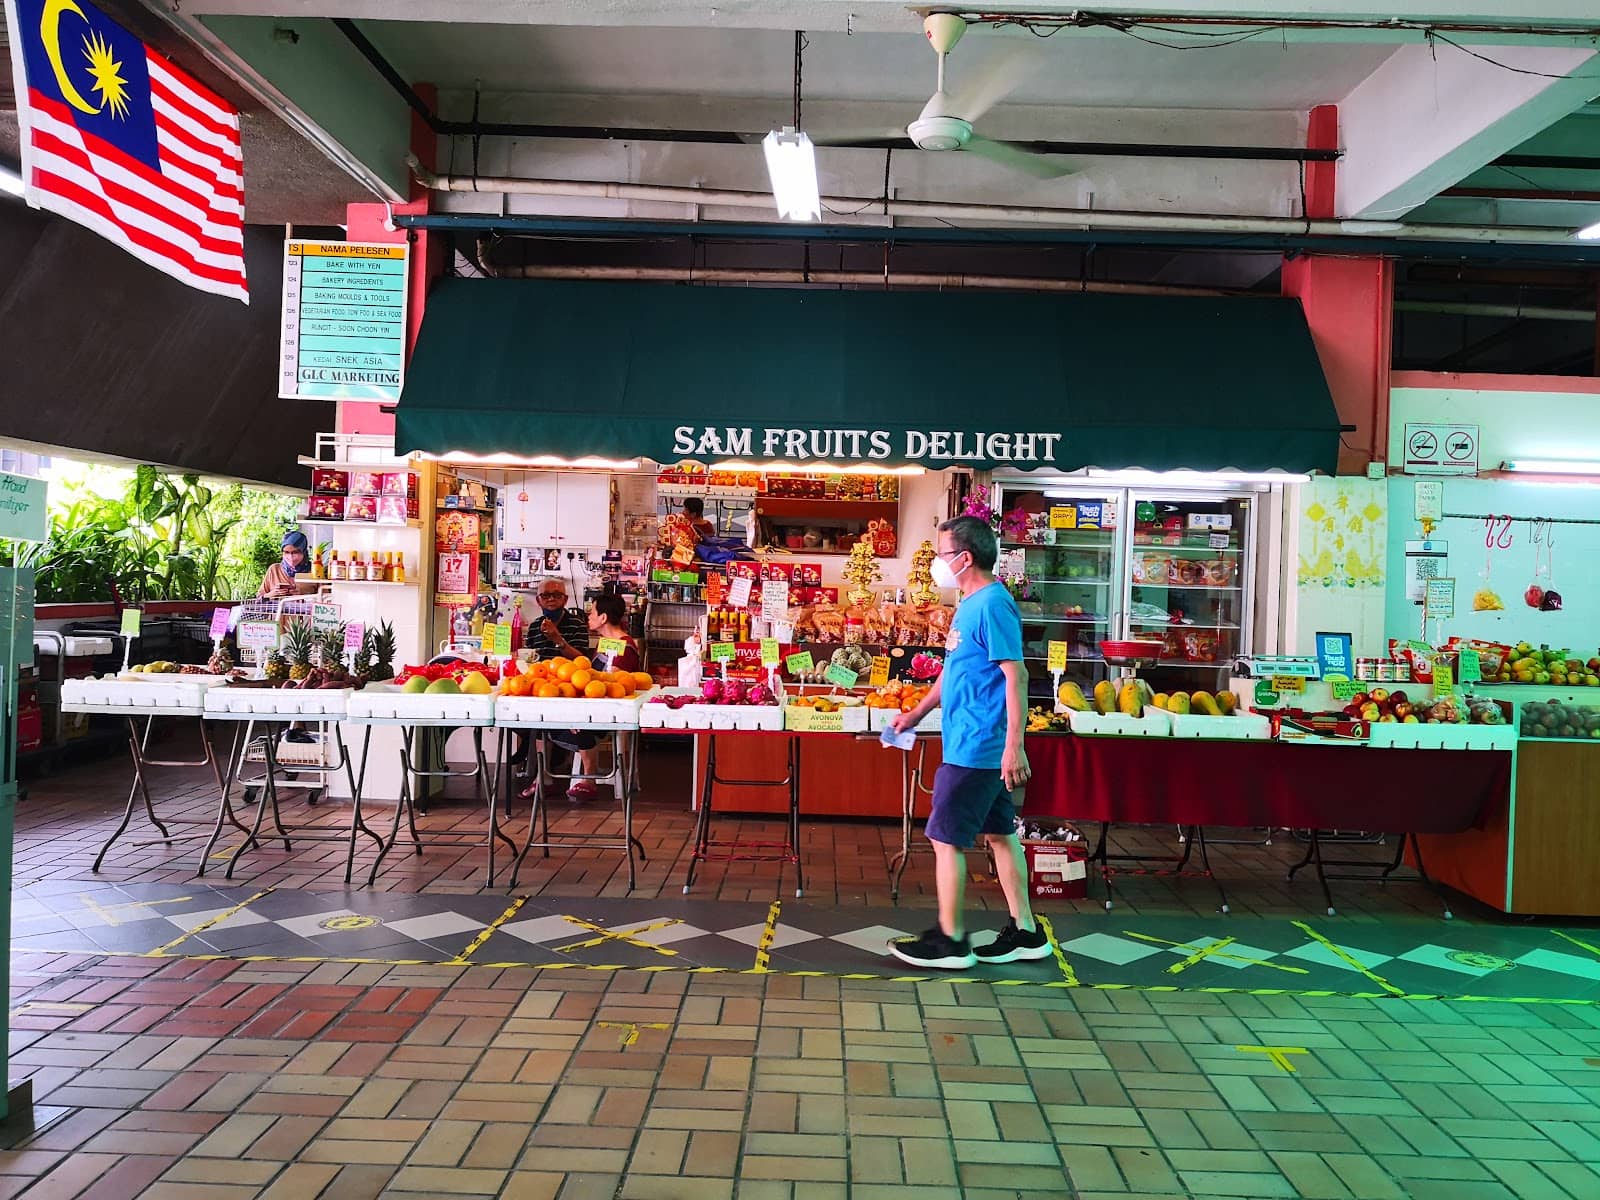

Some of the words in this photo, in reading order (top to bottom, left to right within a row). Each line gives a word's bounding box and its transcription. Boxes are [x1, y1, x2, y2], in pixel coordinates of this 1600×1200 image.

[321, 245, 347, 253] NAMA
[350, 246, 390, 255] PELESEN
[347, 278, 384, 286] INGREDIENTS
[335, 355, 358, 364] SNEK
[363, 357, 383, 365] ASIA
[302, 369, 327, 380] GLC
[331, 371, 400, 383] MARKETING
[672, 425, 754, 456] SAM
[763, 428, 892, 459] FRUITS
[905, 430, 1062, 462] DELIGHT
[445, 558, 463, 573] 17
[315, 605, 336, 615] MD-2
